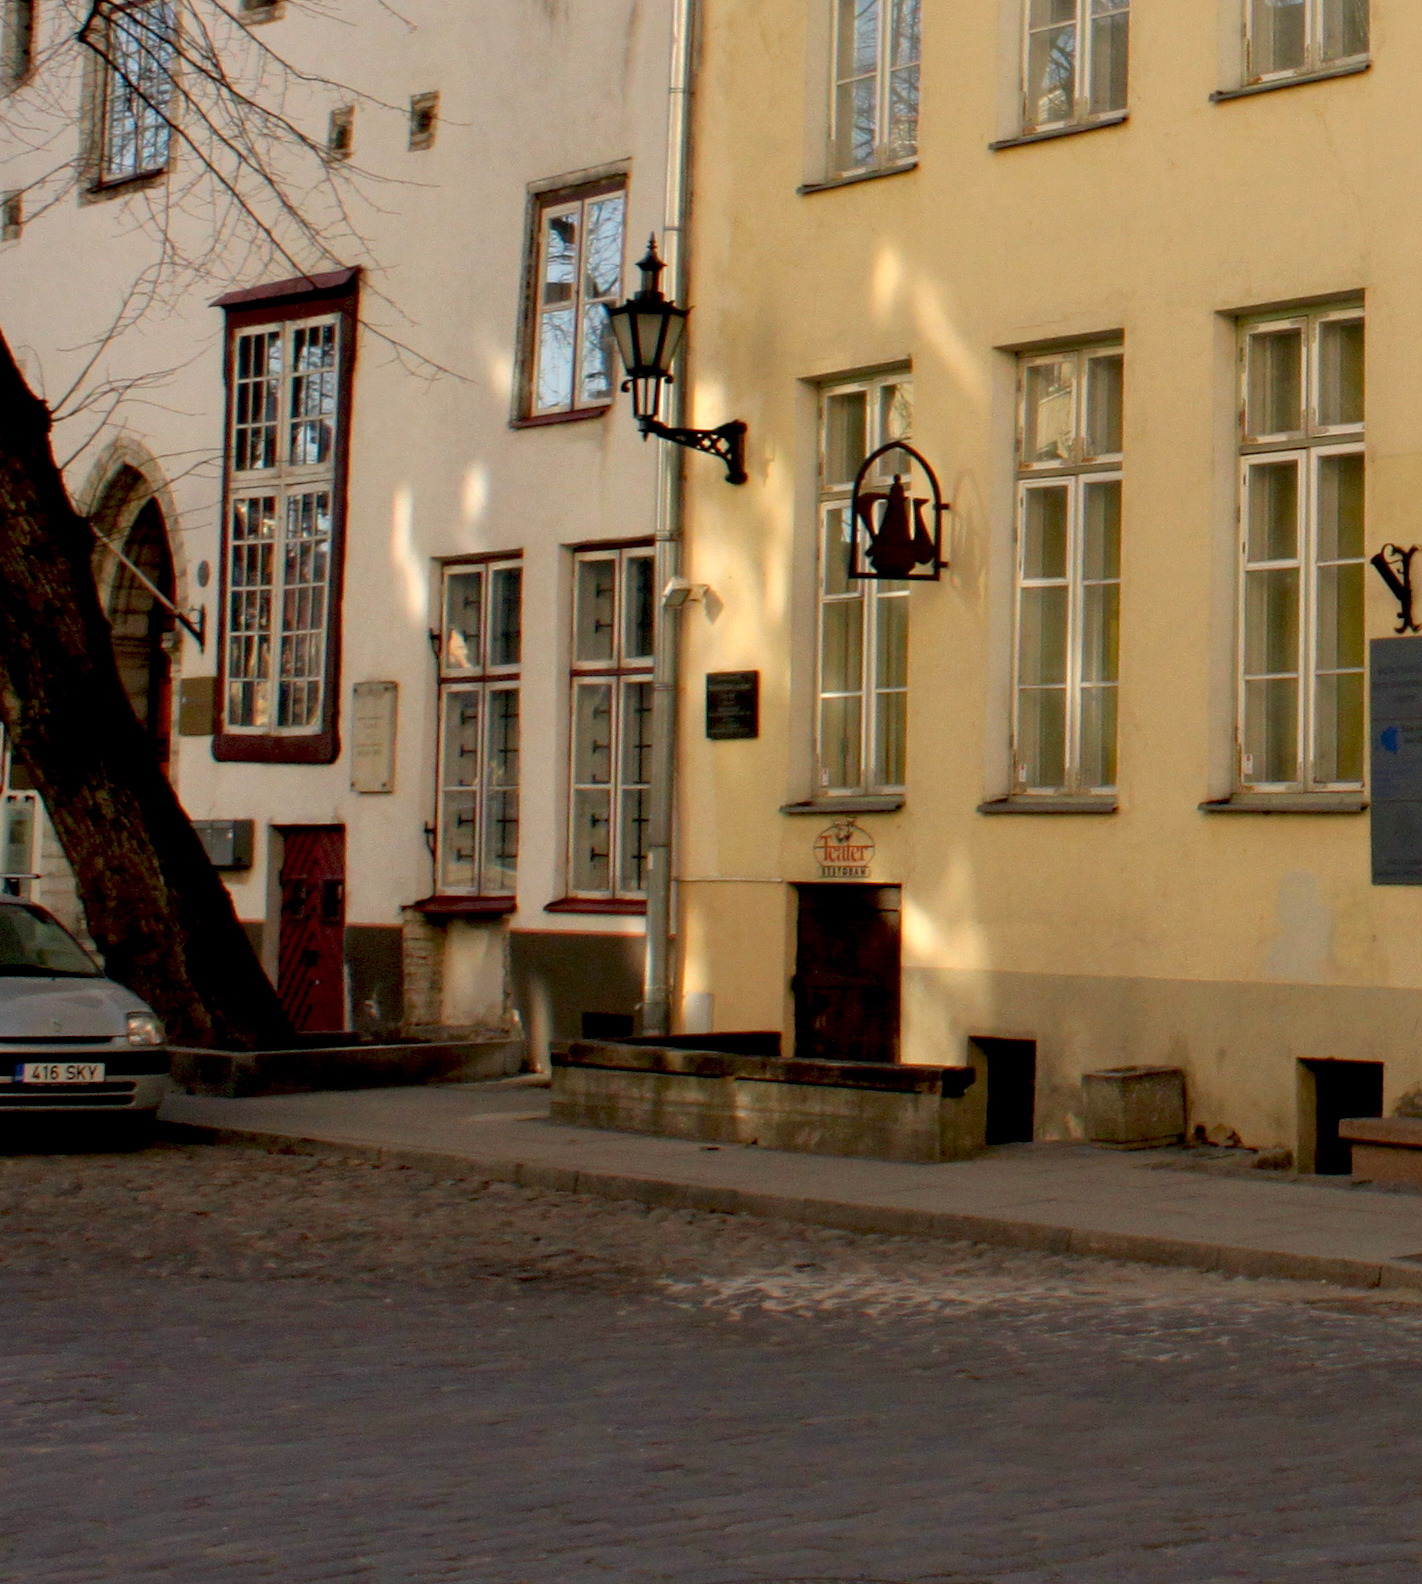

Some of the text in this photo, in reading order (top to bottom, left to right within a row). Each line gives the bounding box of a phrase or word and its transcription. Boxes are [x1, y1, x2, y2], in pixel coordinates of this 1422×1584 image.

[820, 835, 868, 862] Teater
[32, 1064, 98, 1080] 416 SKY
